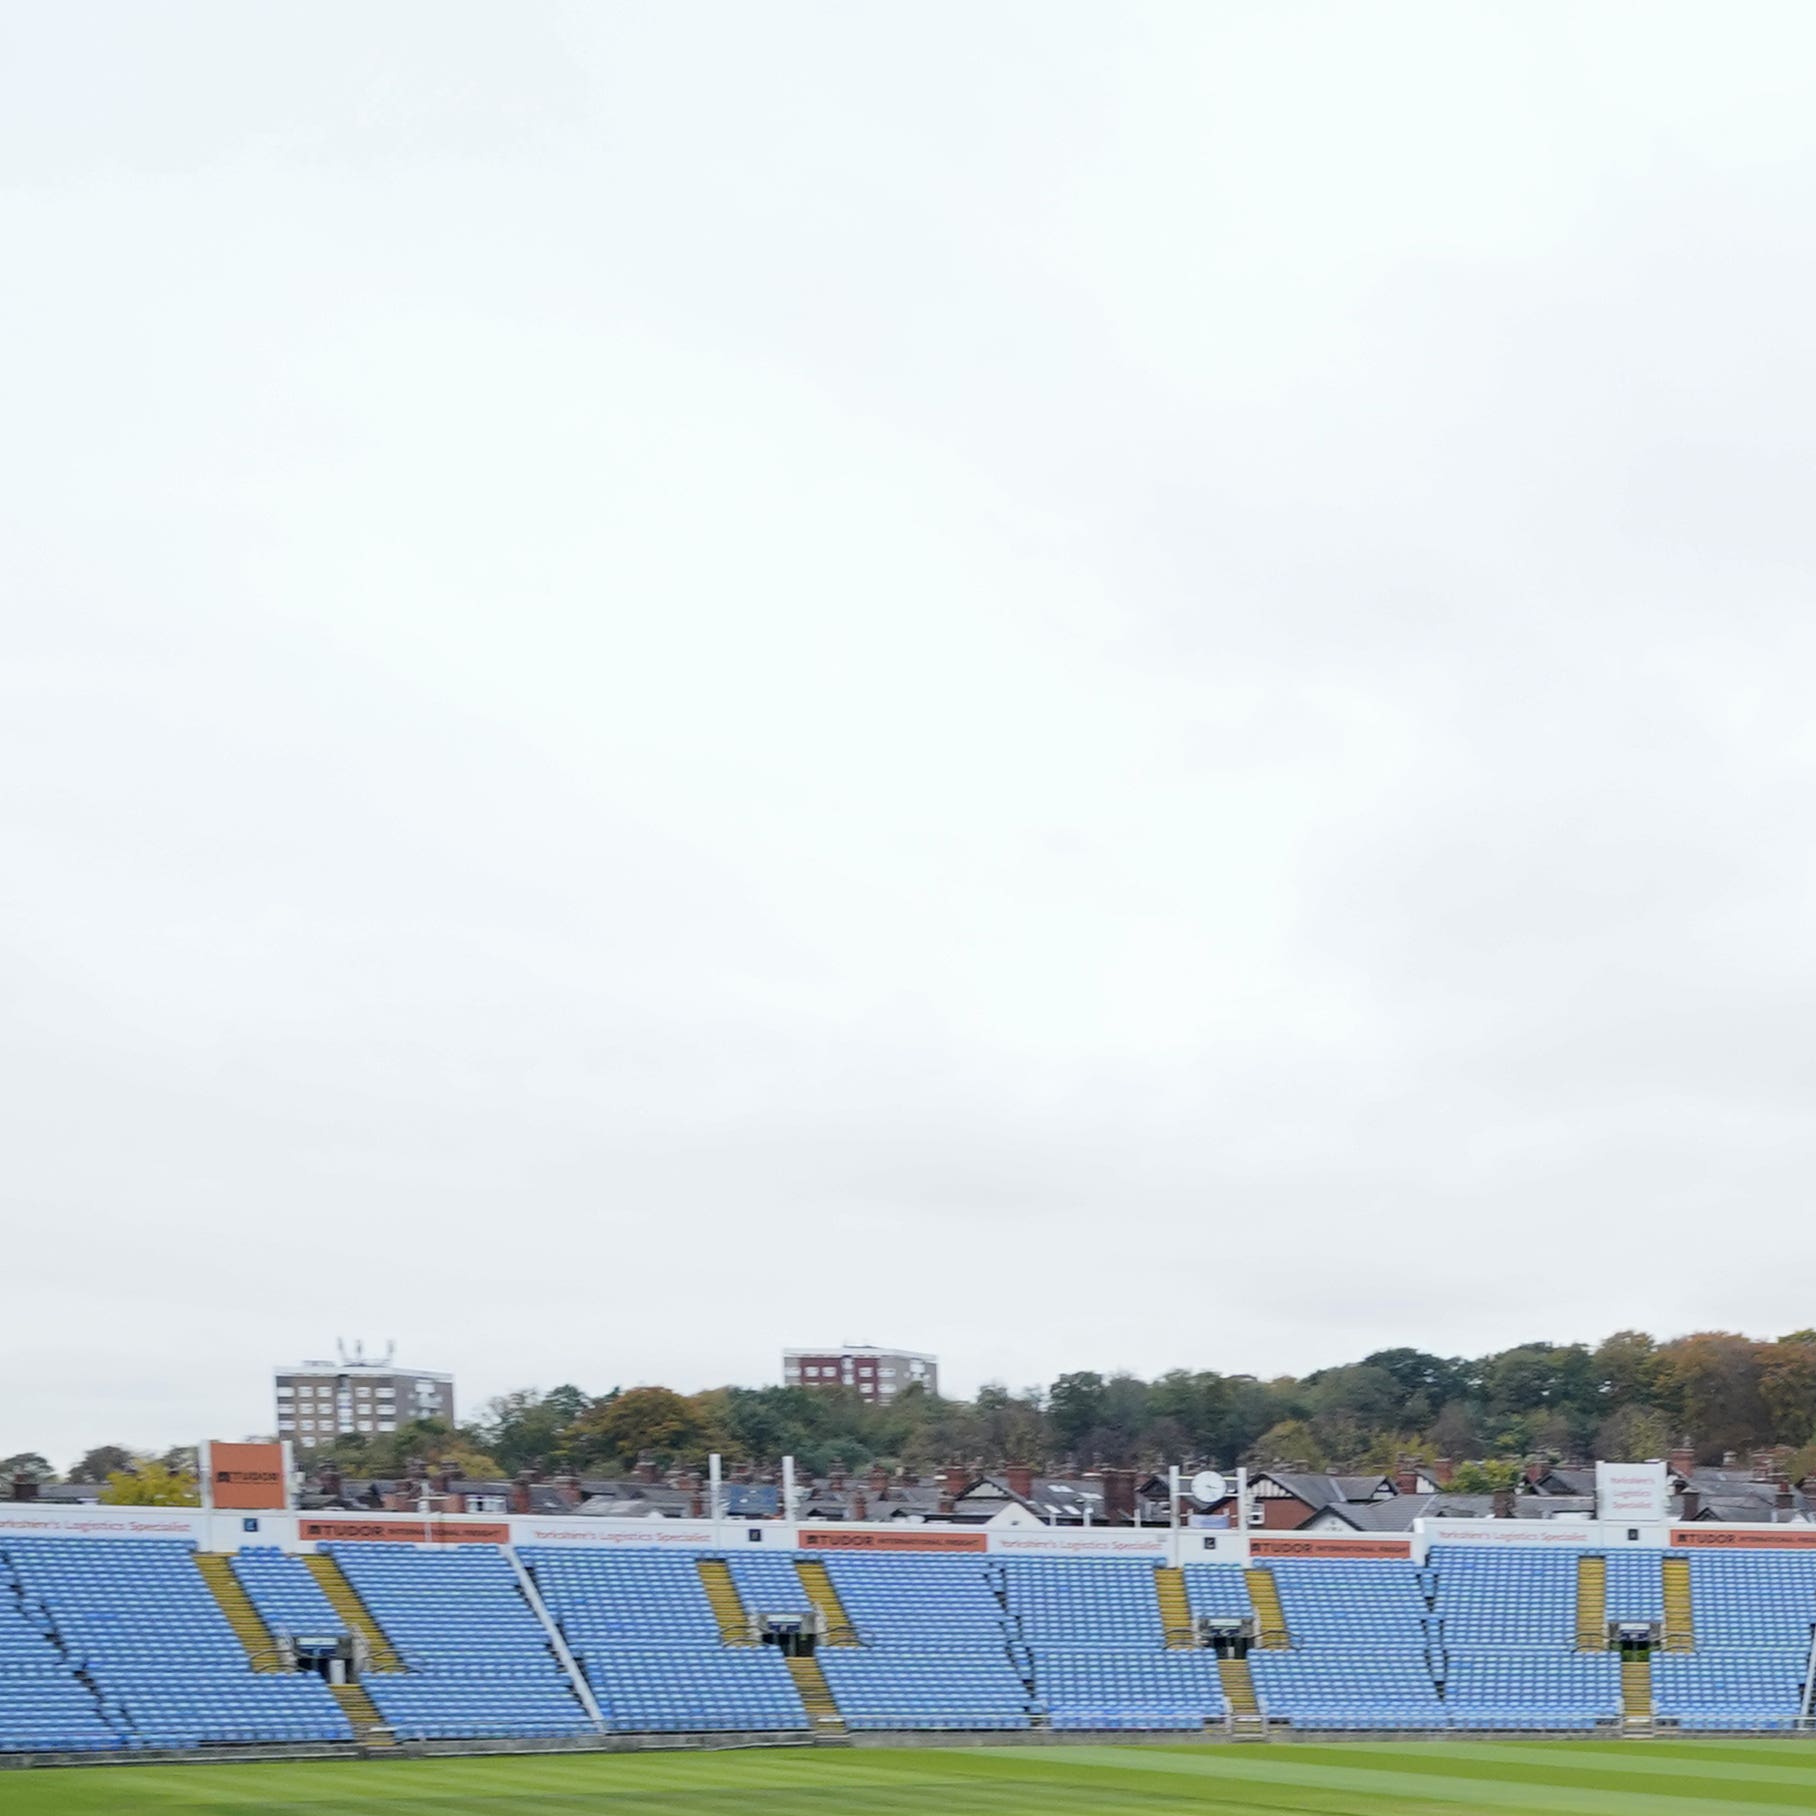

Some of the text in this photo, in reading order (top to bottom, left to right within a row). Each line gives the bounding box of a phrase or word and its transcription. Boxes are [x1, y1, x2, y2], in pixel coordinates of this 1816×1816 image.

[321, 1525, 385, 1537] TUDOR
[820, 1535, 875, 1546] TUDOR
[1688, 1534, 1737, 1544] TUDOR
[1261, 1543, 1313, 1553] TUDOR
